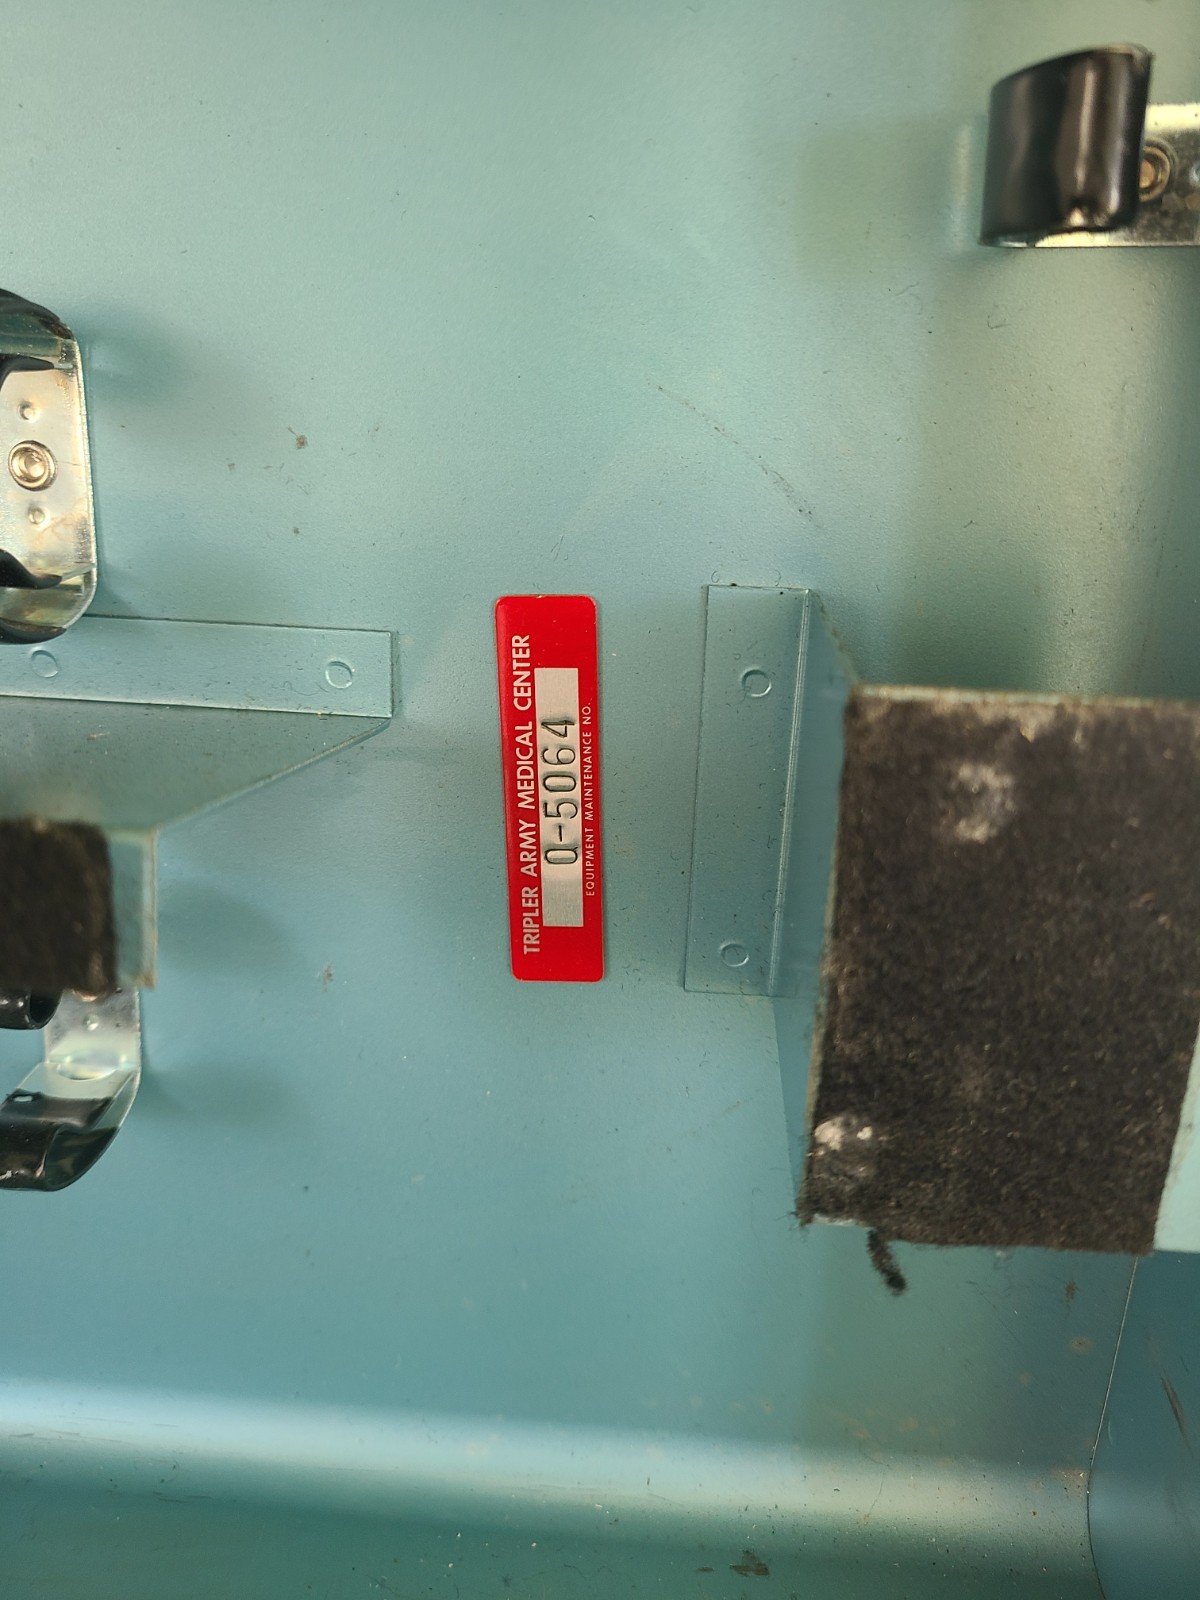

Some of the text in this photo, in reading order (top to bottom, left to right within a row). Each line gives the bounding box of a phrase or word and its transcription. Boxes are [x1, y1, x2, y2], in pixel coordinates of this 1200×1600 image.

[511, 634, 541, 955] TRIPLER ARMY MEDICAL CENTER
[581, 702, 595, 896] EQUIPMENT MAINTENANCE NO.
